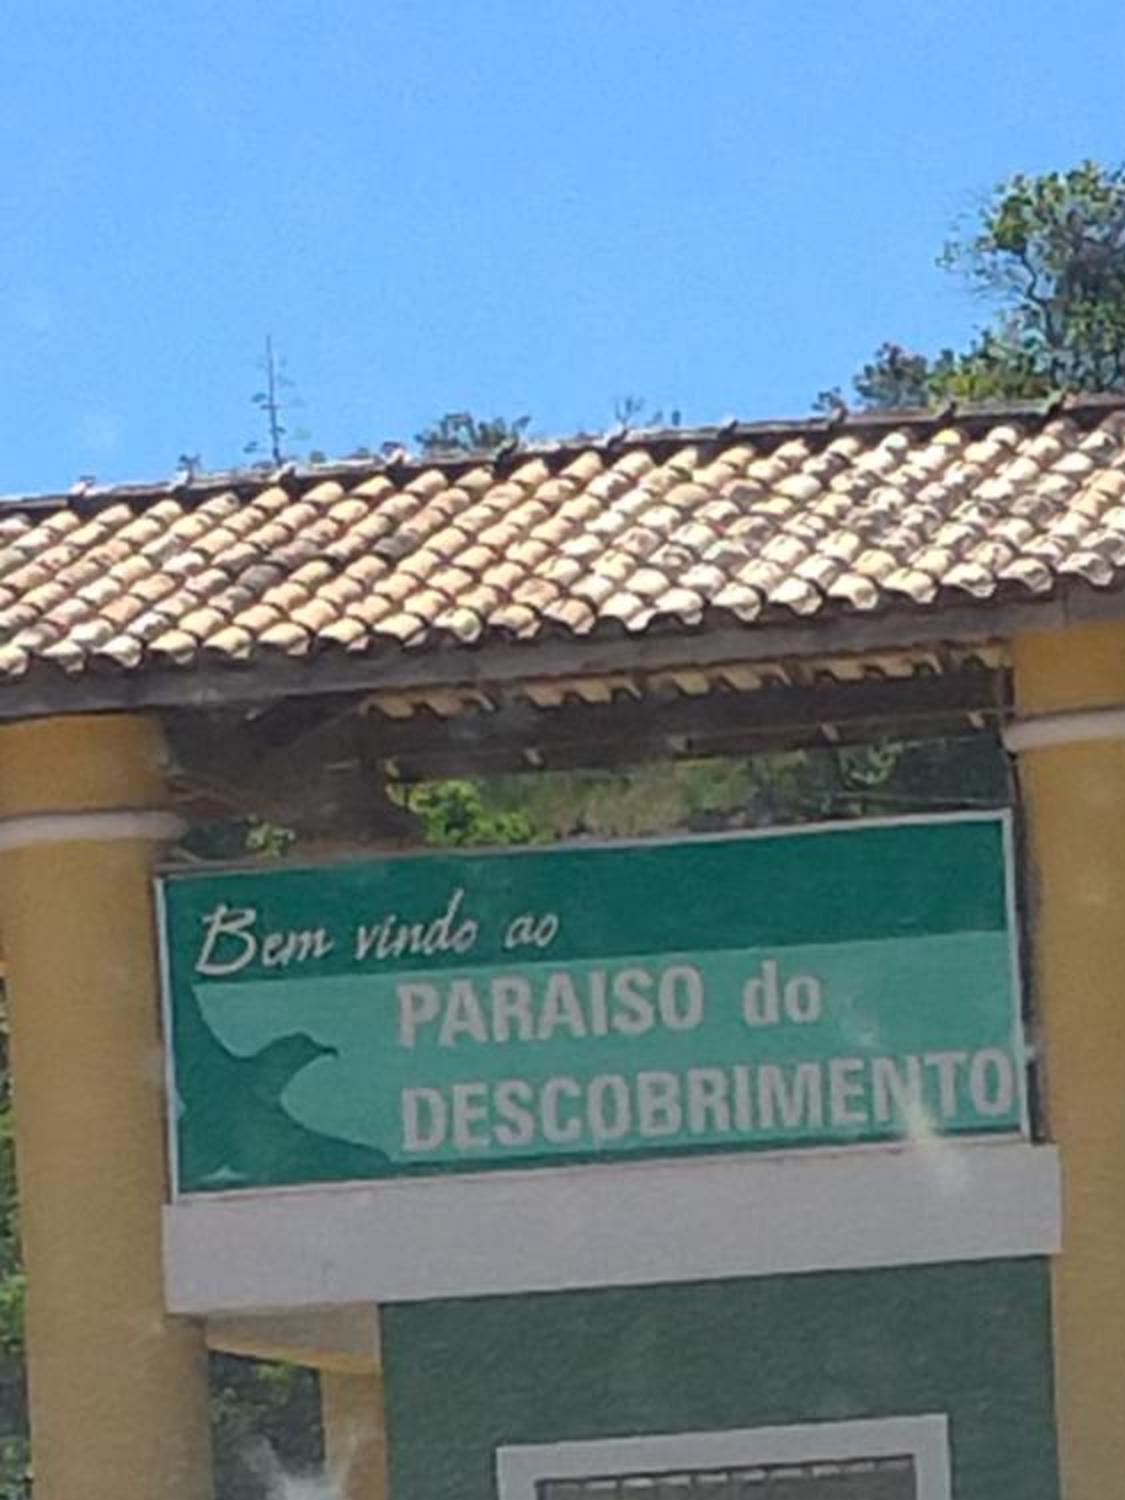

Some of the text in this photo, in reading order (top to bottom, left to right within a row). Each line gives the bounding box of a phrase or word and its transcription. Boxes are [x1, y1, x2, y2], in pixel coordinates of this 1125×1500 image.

[194, 889, 559, 975] Bem vindo ao
[395, 960, 823, 1048] PARAISO do
[400, 1047, 1015, 1153] DESCOBRIMENTO
